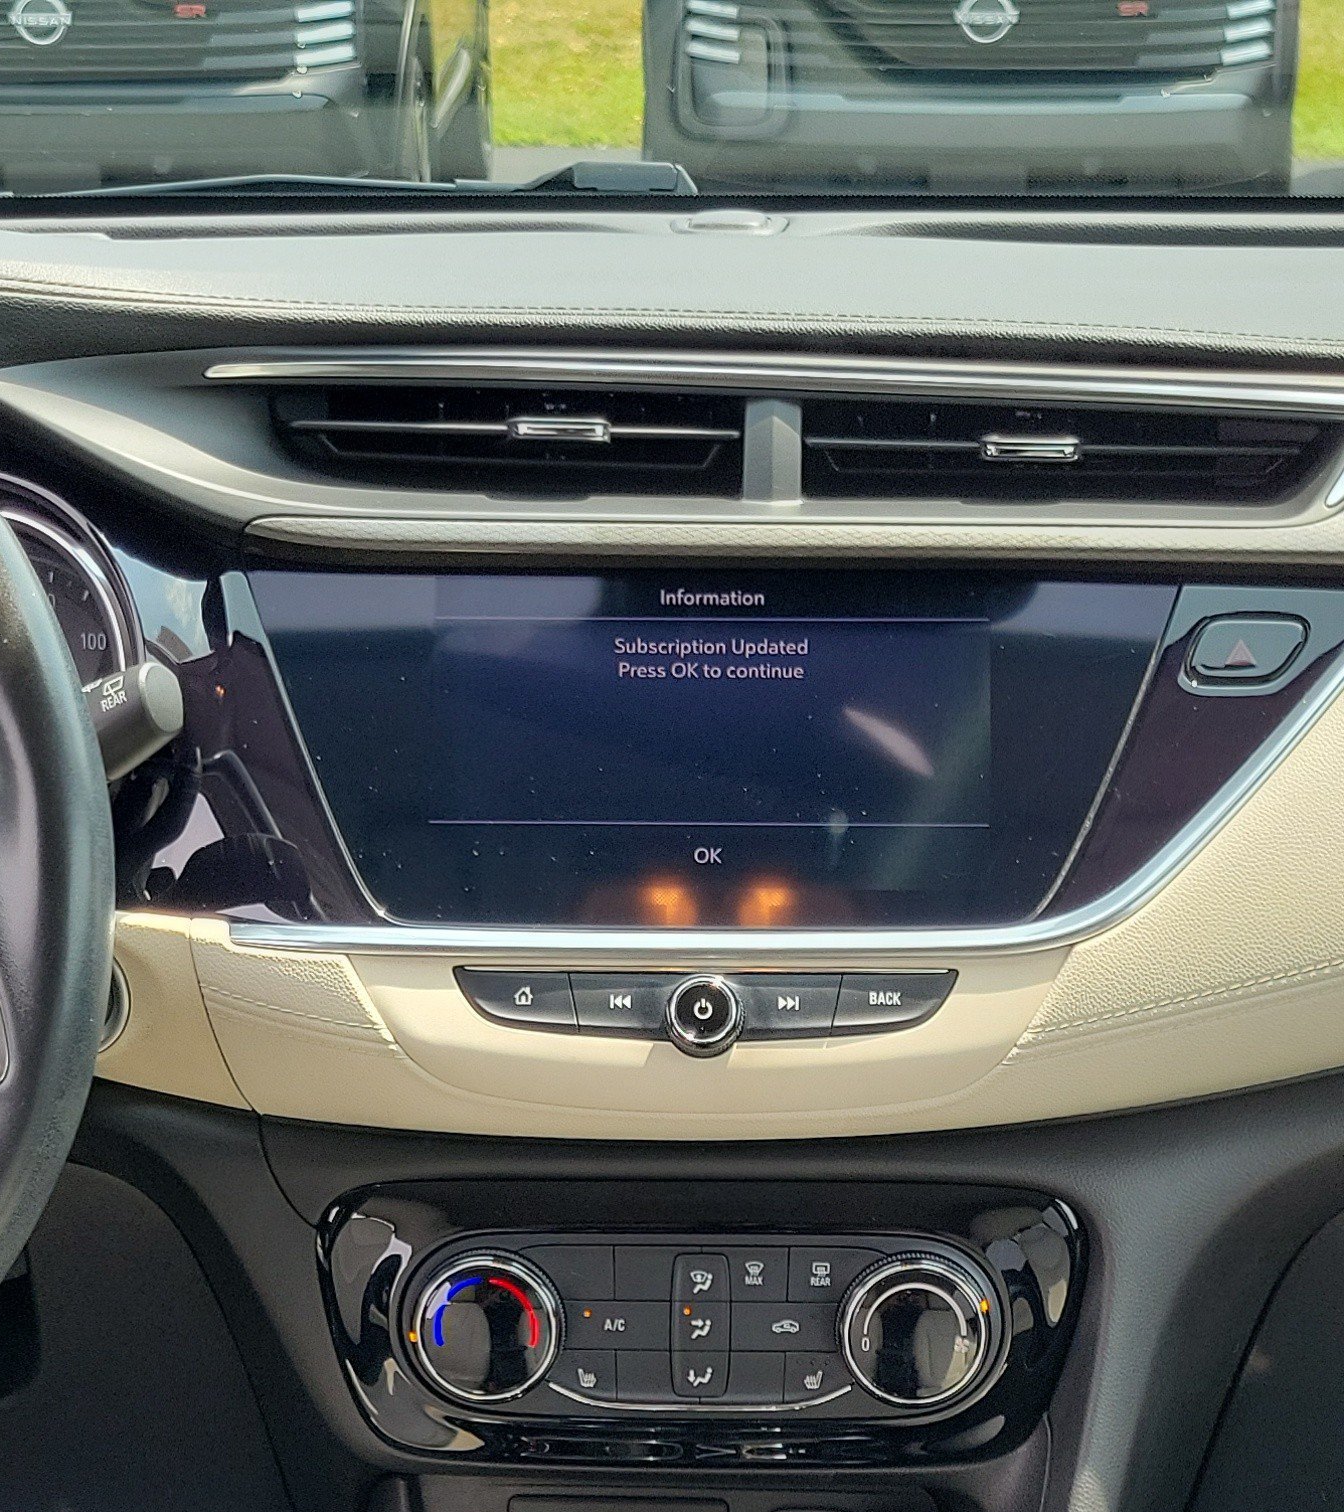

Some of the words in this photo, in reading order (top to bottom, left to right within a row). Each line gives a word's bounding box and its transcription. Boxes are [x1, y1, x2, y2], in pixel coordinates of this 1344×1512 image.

[8, 13, 72, 26] NISSAN
[659, 589, 765, 606] Information
[80, 632, 108, 651] 100
[613, 637, 727, 659] Subscription
[730, 637, 810, 659] Updated
[617, 661, 667, 679] Press
[670, 662, 699, 679] OK
[703, 664, 722, 679] to
[725, 662, 805, 679] continue
[100, 690, 128, 713] REAR
[692, 846, 723, 865] OK
[868, 990, 903, 1007] BACK
[744, 1275, 764, 1286] MAX
[809, 1276, 832, 1287] REAR
[603, 1318, 626, 1332] A/C
[861, 1337, 870, 1351] 0
